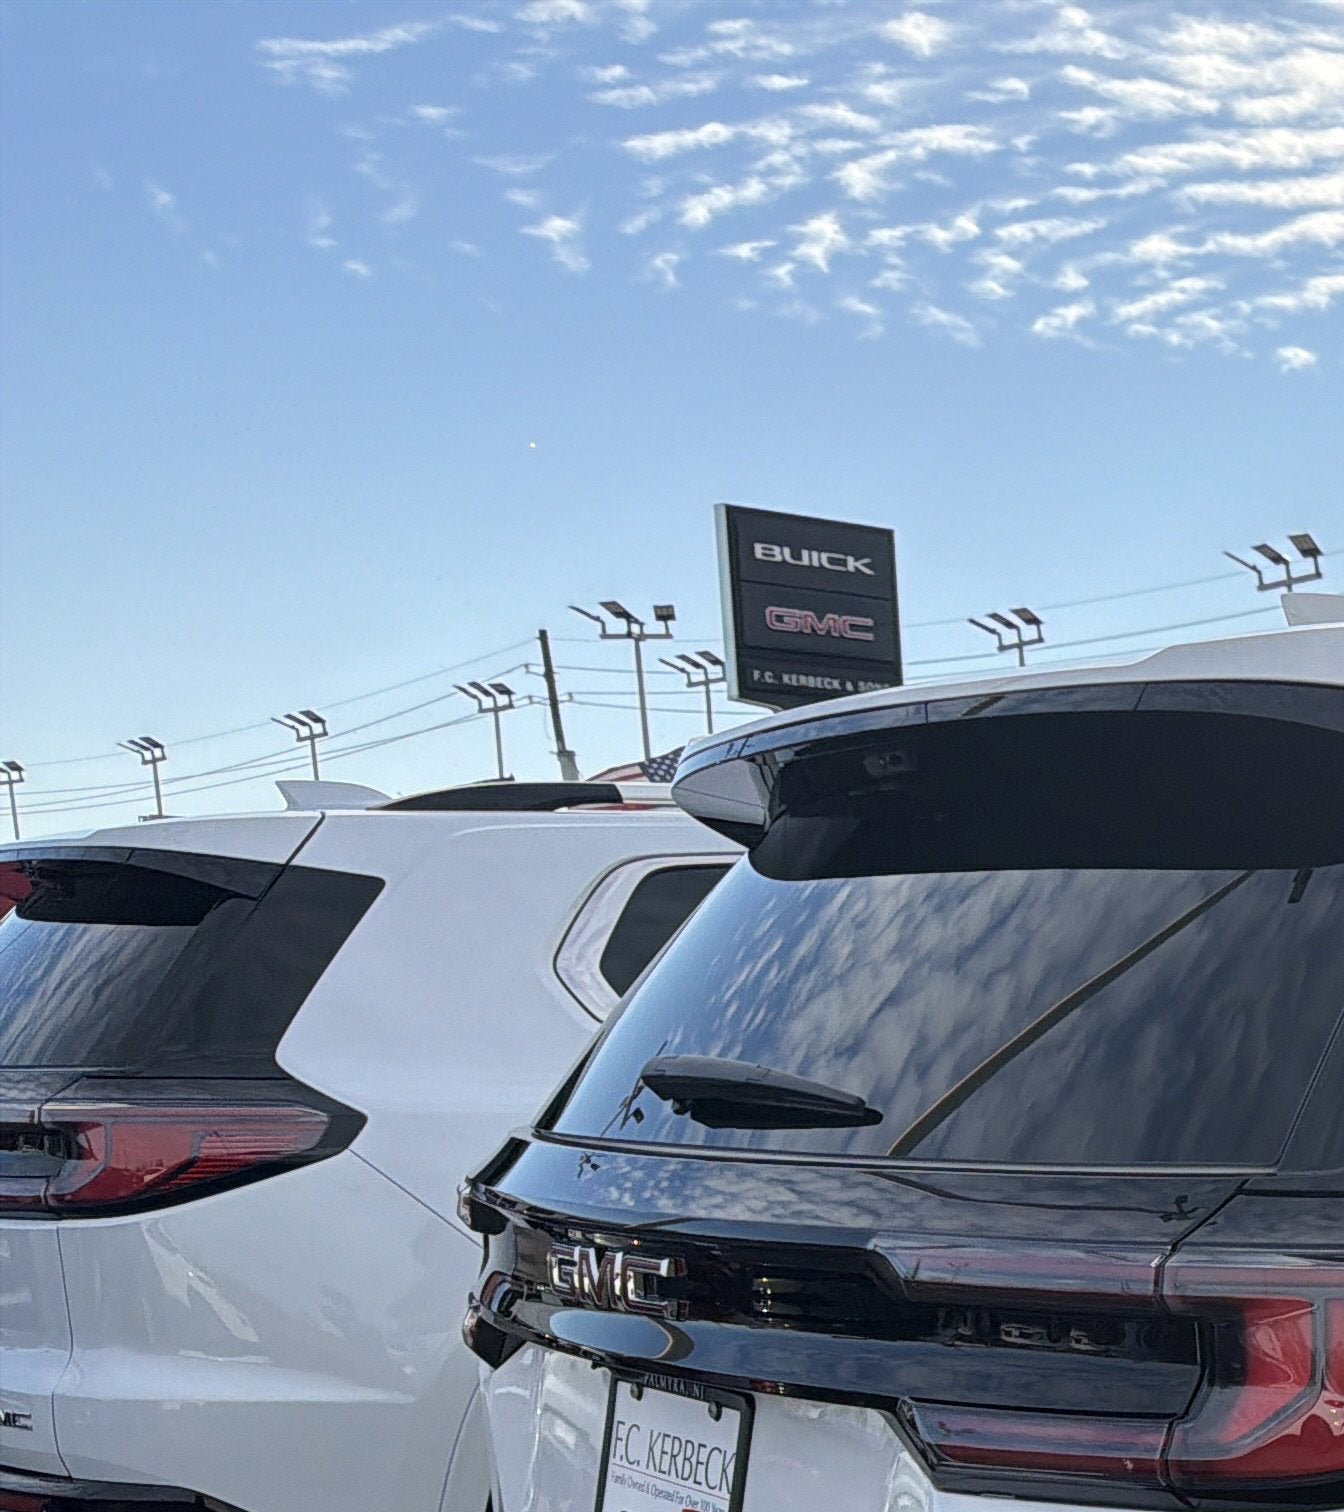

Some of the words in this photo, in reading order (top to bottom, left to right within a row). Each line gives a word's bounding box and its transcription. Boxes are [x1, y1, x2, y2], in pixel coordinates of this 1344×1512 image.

[753, 542, 875, 575] BUICK
[765, 605, 874, 641] GMC
[753, 669, 778, 685] F.C.
[782, 673, 842, 691] KERBECK
[546, 1242, 678, 1320] GMC
[613, 1420, 641, 1467] F.C.
[646, 1429, 737, 1494] KERBECK
[611, 1472, 627, 1488] Family
[628, 1477, 645, 1492] Owned
[651, 1484, 675, 1502] Operated
[675, 1491, 685, 1505] For
[685, 1495, 699, 1508] Over
